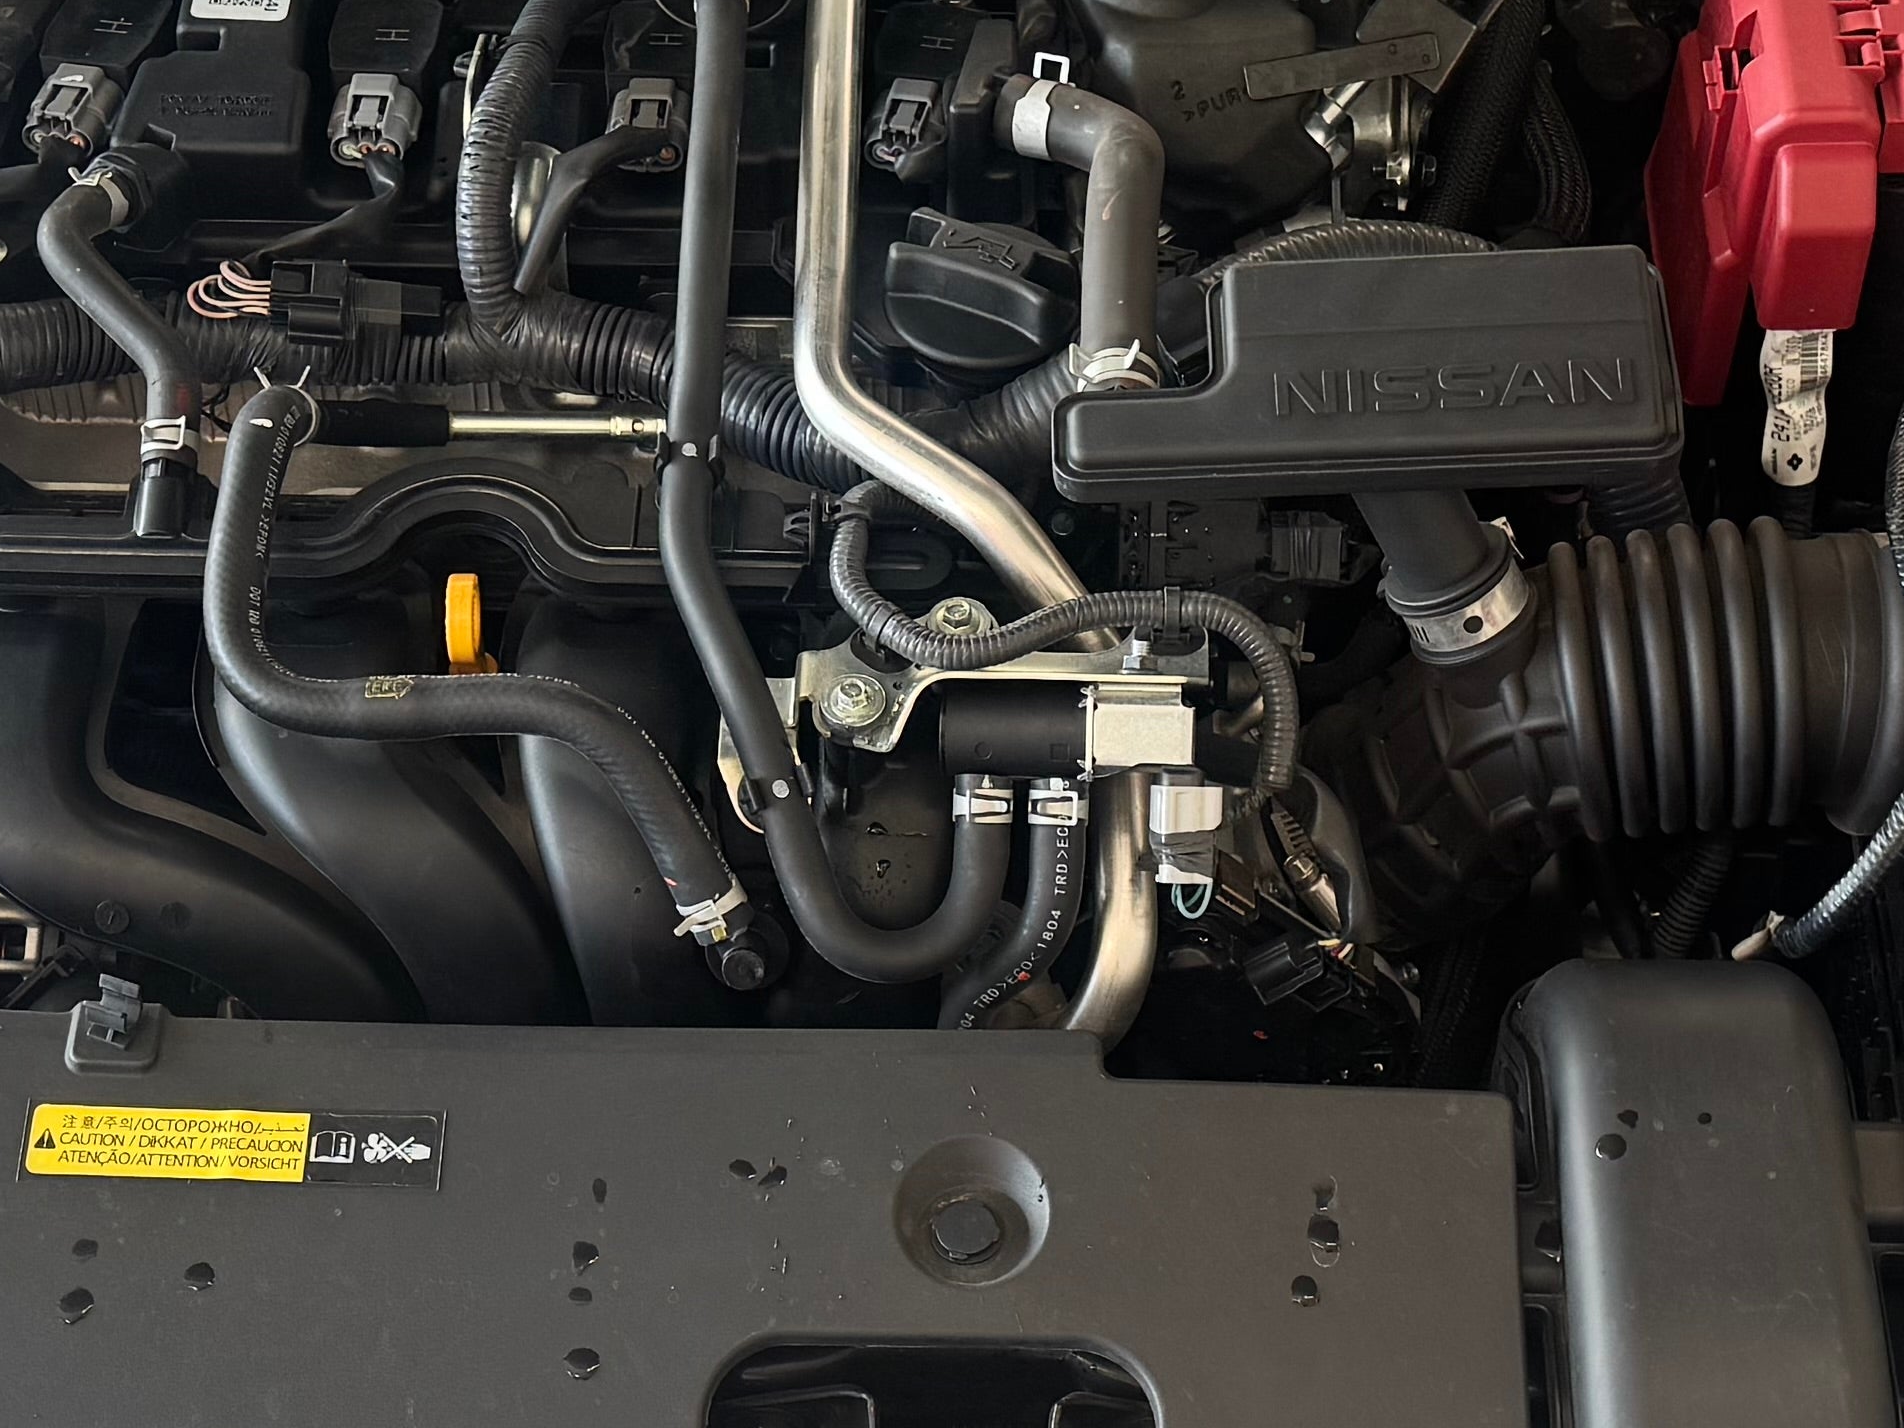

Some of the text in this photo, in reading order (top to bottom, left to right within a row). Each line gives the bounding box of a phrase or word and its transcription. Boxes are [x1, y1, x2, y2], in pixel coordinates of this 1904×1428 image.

[1272, 357, 1638, 418] NISSAN
[1036, 909, 1061, 949] 1804
[59, 1132, 125, 1147] CAUTION
[210, 1137, 303, 1153] PRECAUCION
